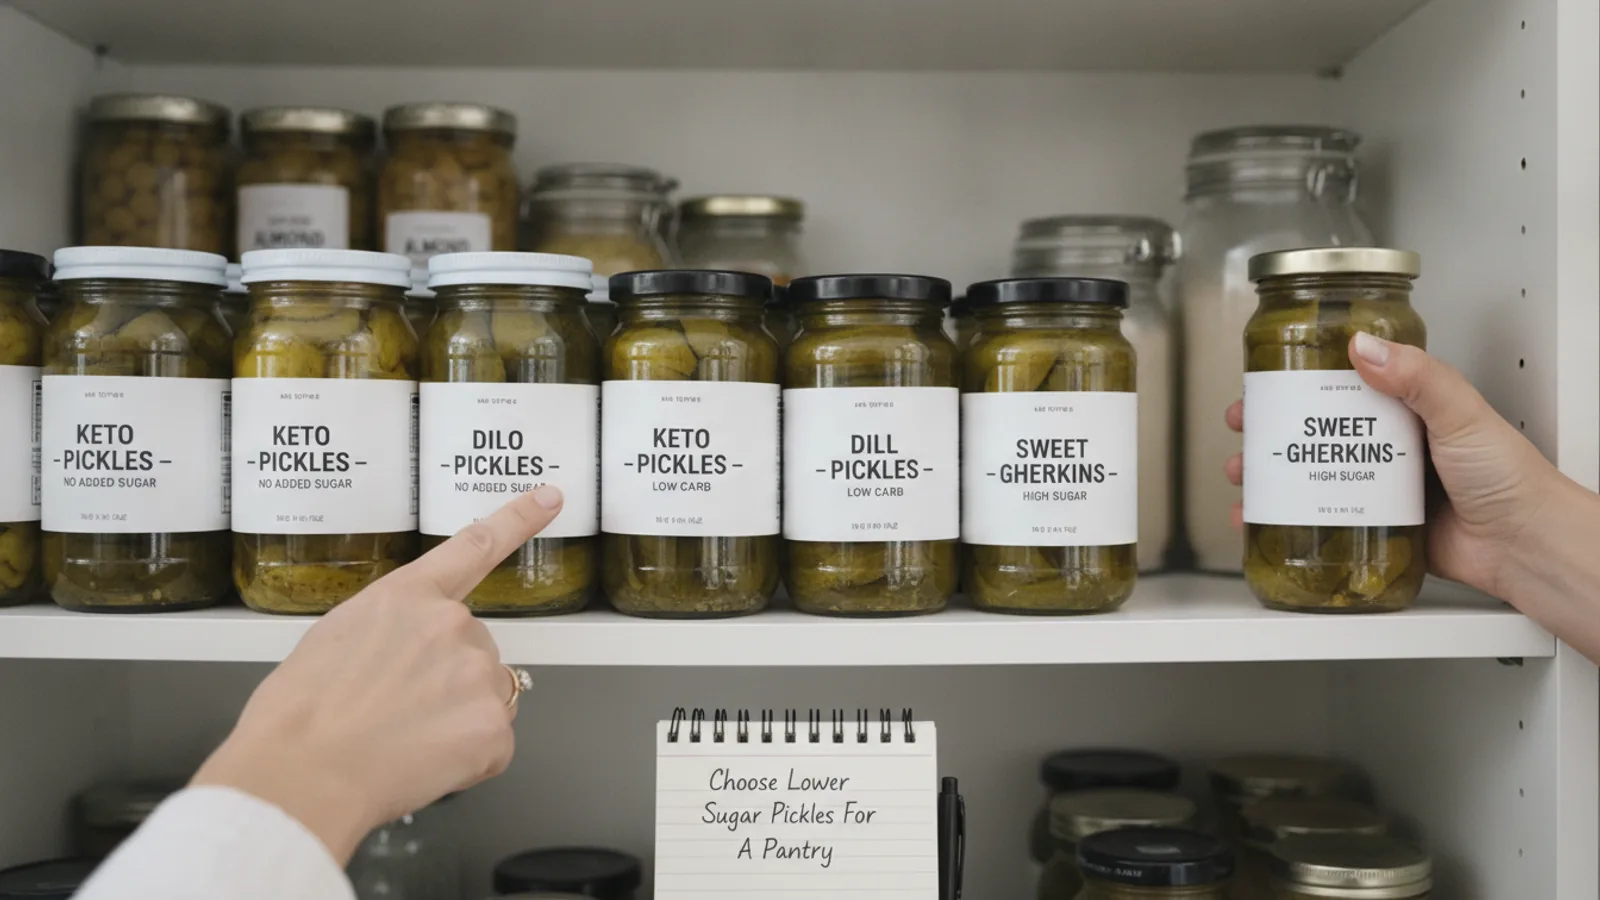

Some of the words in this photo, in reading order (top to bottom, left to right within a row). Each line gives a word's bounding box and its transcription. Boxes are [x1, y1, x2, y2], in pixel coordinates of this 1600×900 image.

[76, 423, 134, 446] KETO
[272, 425, 331, 447] KETO
[1303, 416, 1378, 438] SWEET
[472, 429, 524, 451] DILO
[653, 427, 710, 450] KETO
[851, 433, 899, 455] DILL
[1016, 438, 1089, 459] SWEET
[63, 449, 154, 472] PICKLES
[259, 451, 350, 473] PICKLES
[1286, 442, 1394, 464] GHERKINS
[454, 455, 544, 477] PICKLES
[637, 453, 727, 476] PICKLES
[831, 458, 919, 480] PICKLES
[1000, 463, 1106, 484] GHERKINS
[63, 476, 77, 488] NO
[117, 477, 157, 489] SUGAR
[258, 478, 273, 490] NO
[275, 478, 312, 490] ADDED
[314, 478, 353, 490] SUGAR
[454, 482, 469, 492] NO
[652, 481, 678, 492] LOW
[679, 481, 712, 493] CARB
[1308, 470, 1337, 482] HIGH
[1339, 470, 1376, 482] SUGAR
[847, 486, 872, 498] LOW
[874, 486, 904, 498] CARB
[1022, 490, 1049, 502] HIGH
[1052, 490, 1088, 502] SUGAR
[709, 767, 778, 791] Choose
[787, 767, 850, 792] Lower
[701, 800, 762, 832] Sugar
[771, 801, 835, 825] Pickles
[843, 800, 879, 824] For
[737, 837, 753, 860] A
[762, 837, 833, 869] Pantry
